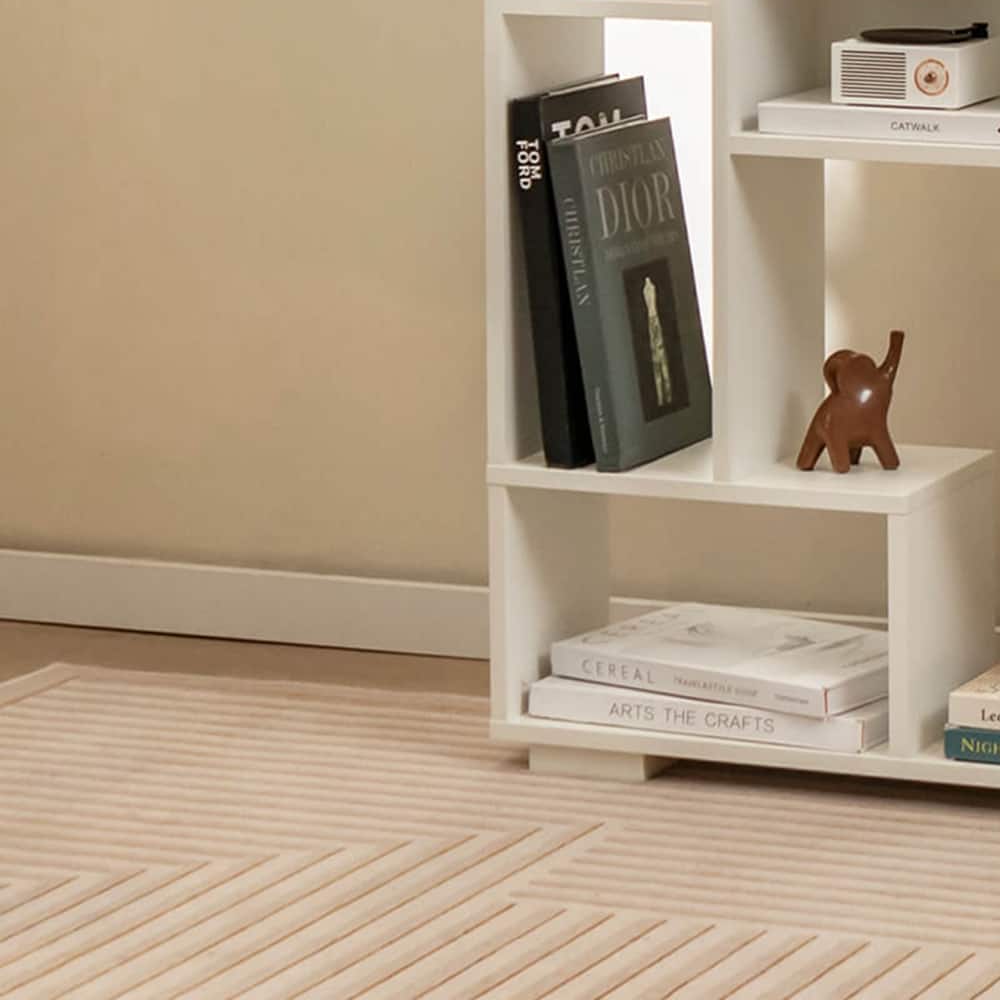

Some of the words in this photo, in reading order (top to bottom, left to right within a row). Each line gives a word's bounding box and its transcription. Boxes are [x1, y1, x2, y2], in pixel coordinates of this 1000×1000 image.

[890, 120, 940, 133] CATWALK
[516, 140, 532, 190] FORD
[527, 138, 542, 180] TOM
[596, 171, 676, 240] DIOR
[562, 198, 590, 306] CHRISTIAN
[581, 659, 656, 684] CEREAL
[609, 702, 655, 721] ARTS
[664, 707, 696, 727] THE
[704, 708, 775, 734] CRAFTS
